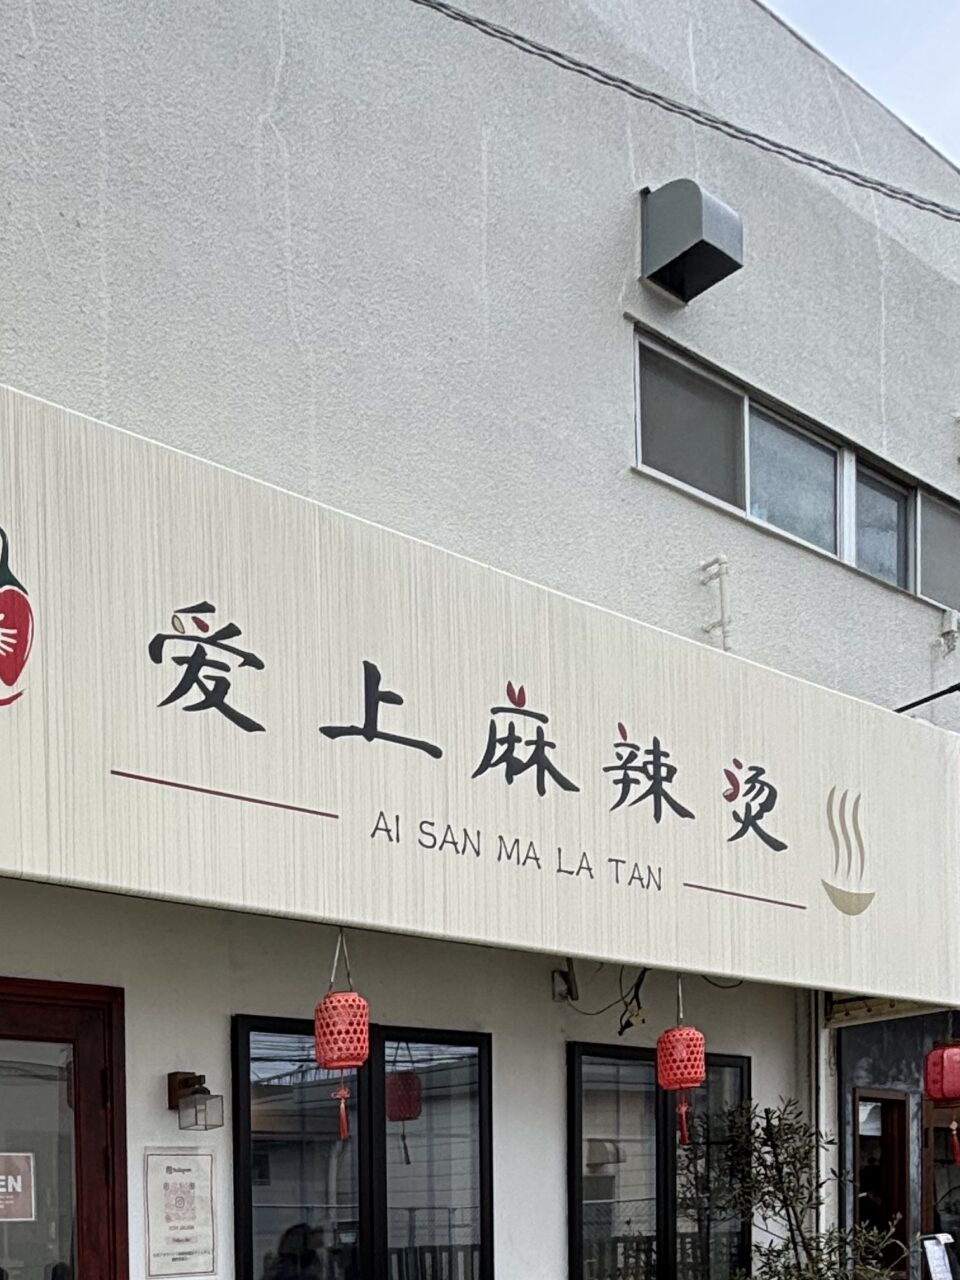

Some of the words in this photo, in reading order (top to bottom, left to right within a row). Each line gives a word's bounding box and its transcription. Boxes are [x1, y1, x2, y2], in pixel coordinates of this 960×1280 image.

[147, 600, 790, 853] 爱上麻辣烫
[370, 810, 401, 844] AI
[418, 820, 481, 858] SAN
[497, 834, 542, 871] MA
[556, 846, 594, 879] LA
[607, 857, 662, 891] TAN
